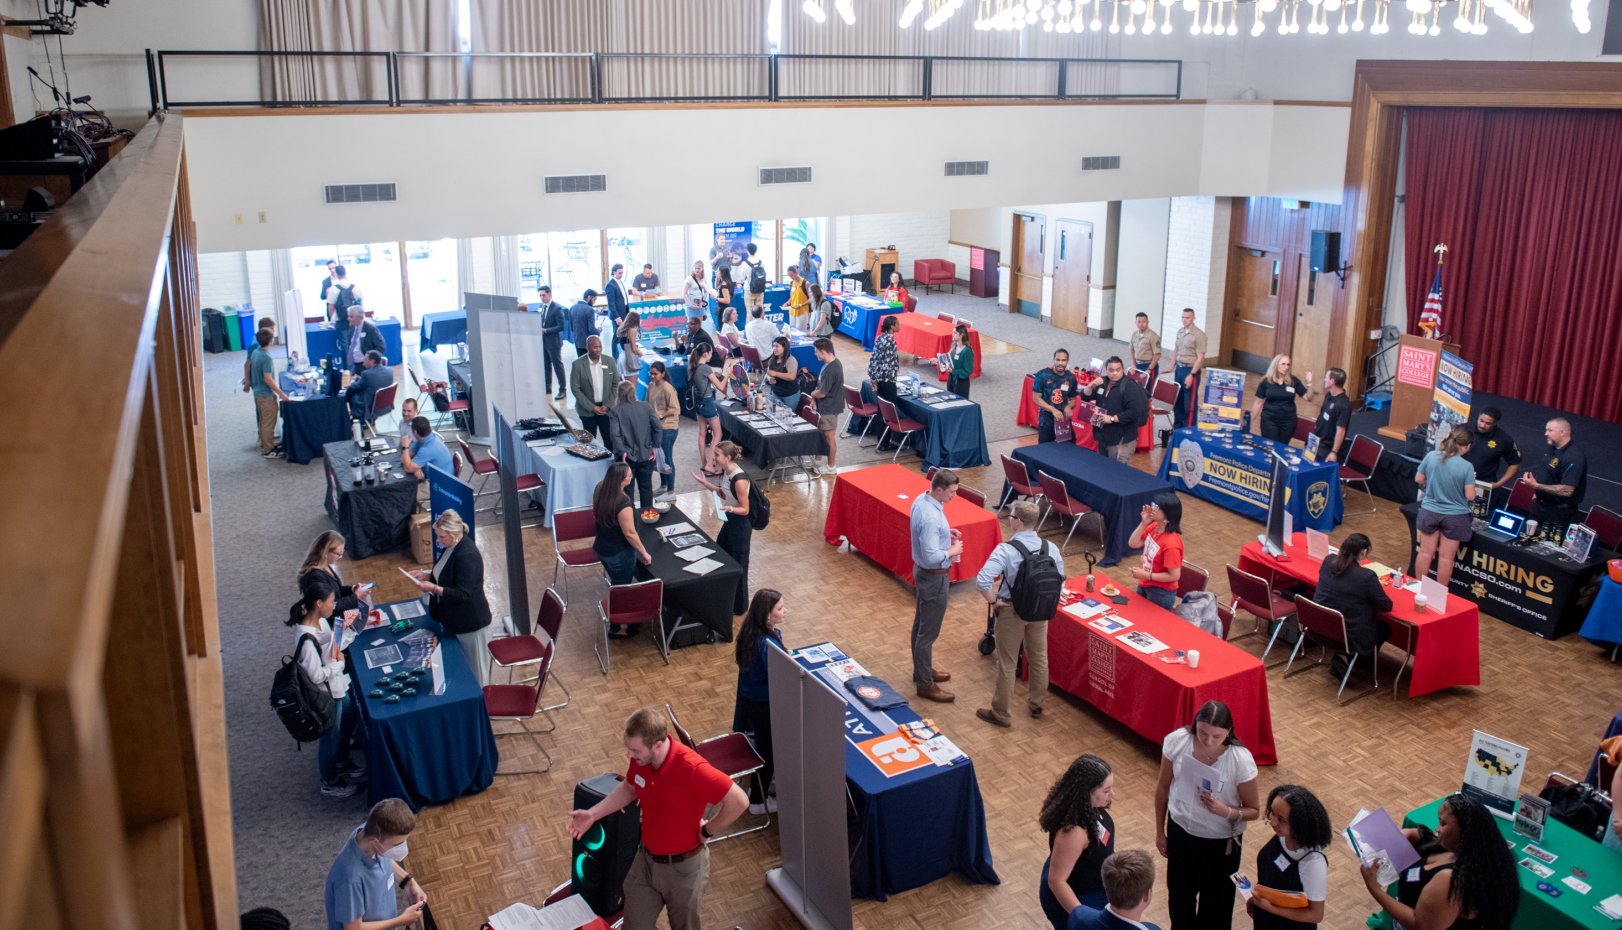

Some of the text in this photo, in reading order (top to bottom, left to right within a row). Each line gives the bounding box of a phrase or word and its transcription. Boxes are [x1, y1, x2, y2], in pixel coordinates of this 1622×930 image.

[764, 313, 784, 322] STER
[1402, 359, 1431, 371] MARY'S
[1403, 350, 1432, 362] SAINT
[1401, 368, 1430, 380] COLLEGE
[1210, 451, 1232, 465] Fremont
[1232, 459, 1249, 471] Police
[1248, 464, 1270, 478] Departm
[1210, 462, 1270, 493] NOW HIRIN
[1208, 475, 1270, 504] Fremontpolice.gov/hir
[1452, 561, 1522, 594] INACSO.com
[1472, 550, 1555, 593] HIRING
[1449, 577, 1548, 621] OUNTY SHERIFF'S OFFICE
